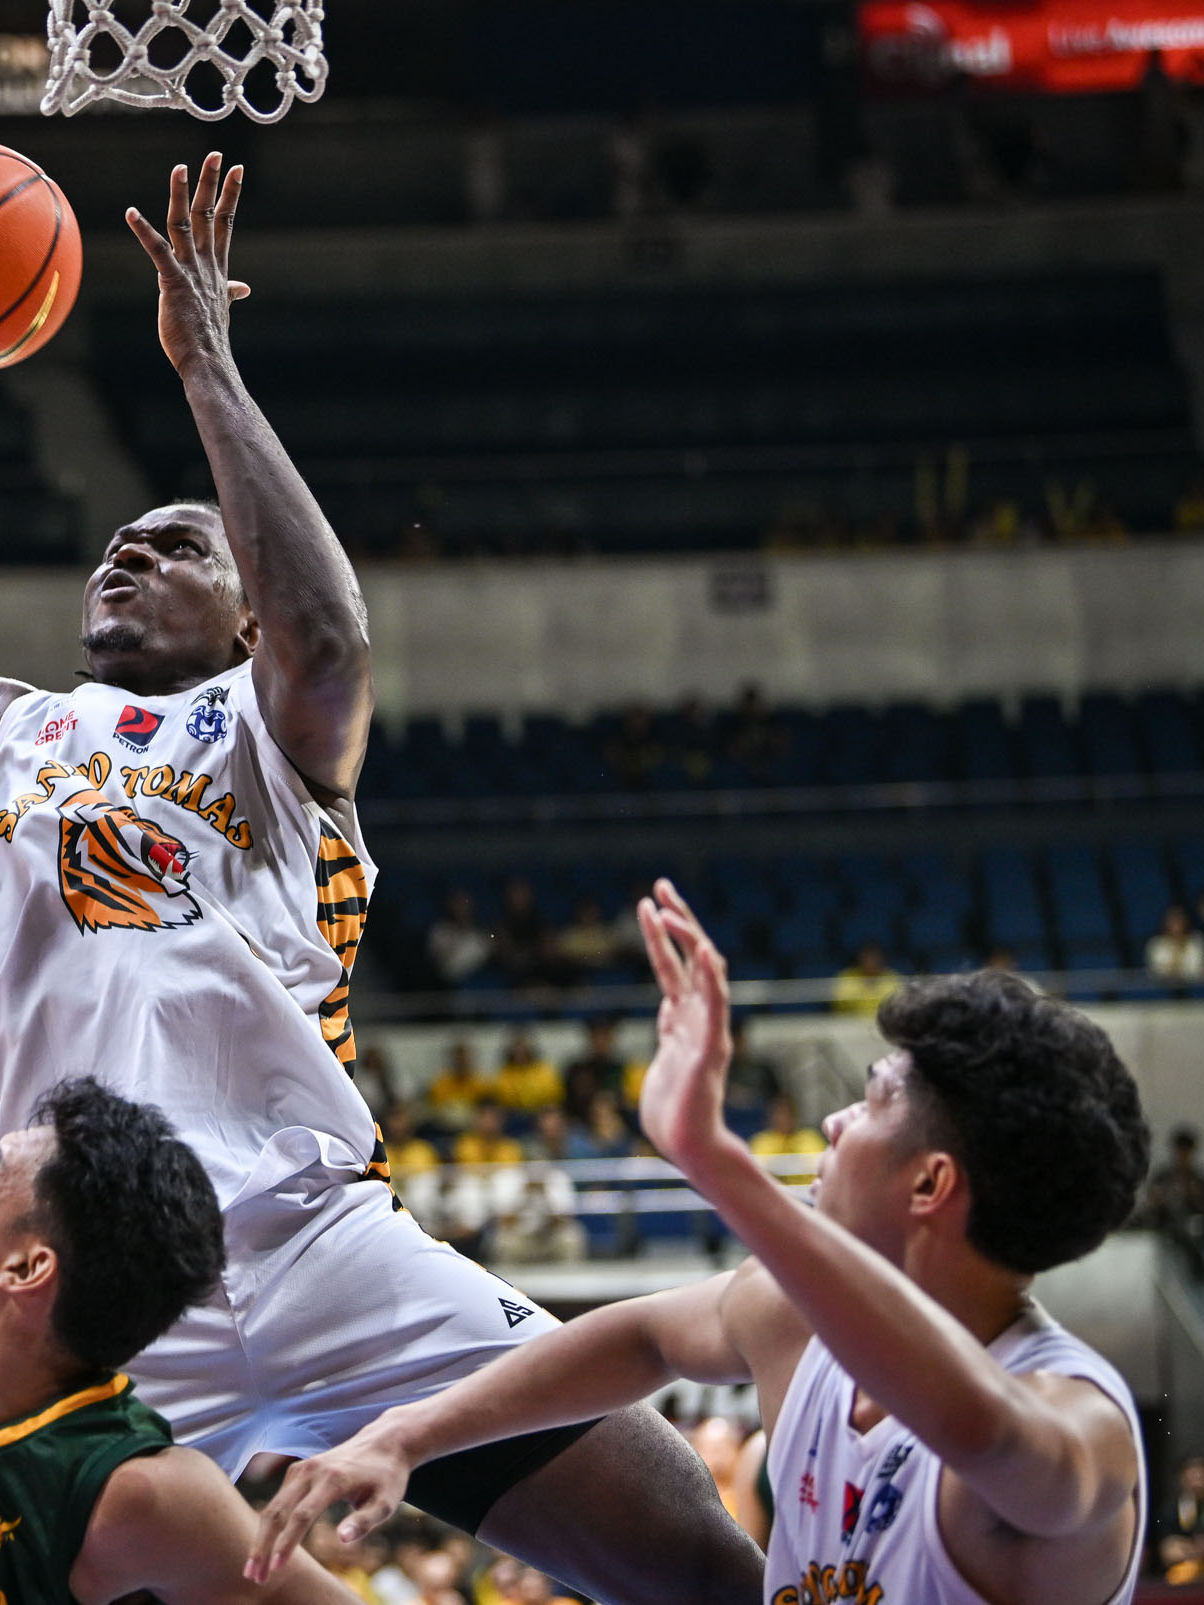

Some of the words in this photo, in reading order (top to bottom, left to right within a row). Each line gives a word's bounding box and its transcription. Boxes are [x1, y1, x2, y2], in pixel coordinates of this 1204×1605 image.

[35, 718, 78, 746] CREIT
[112, 731, 149, 754] PETRON
[120, 764, 254, 850] TOMAS
